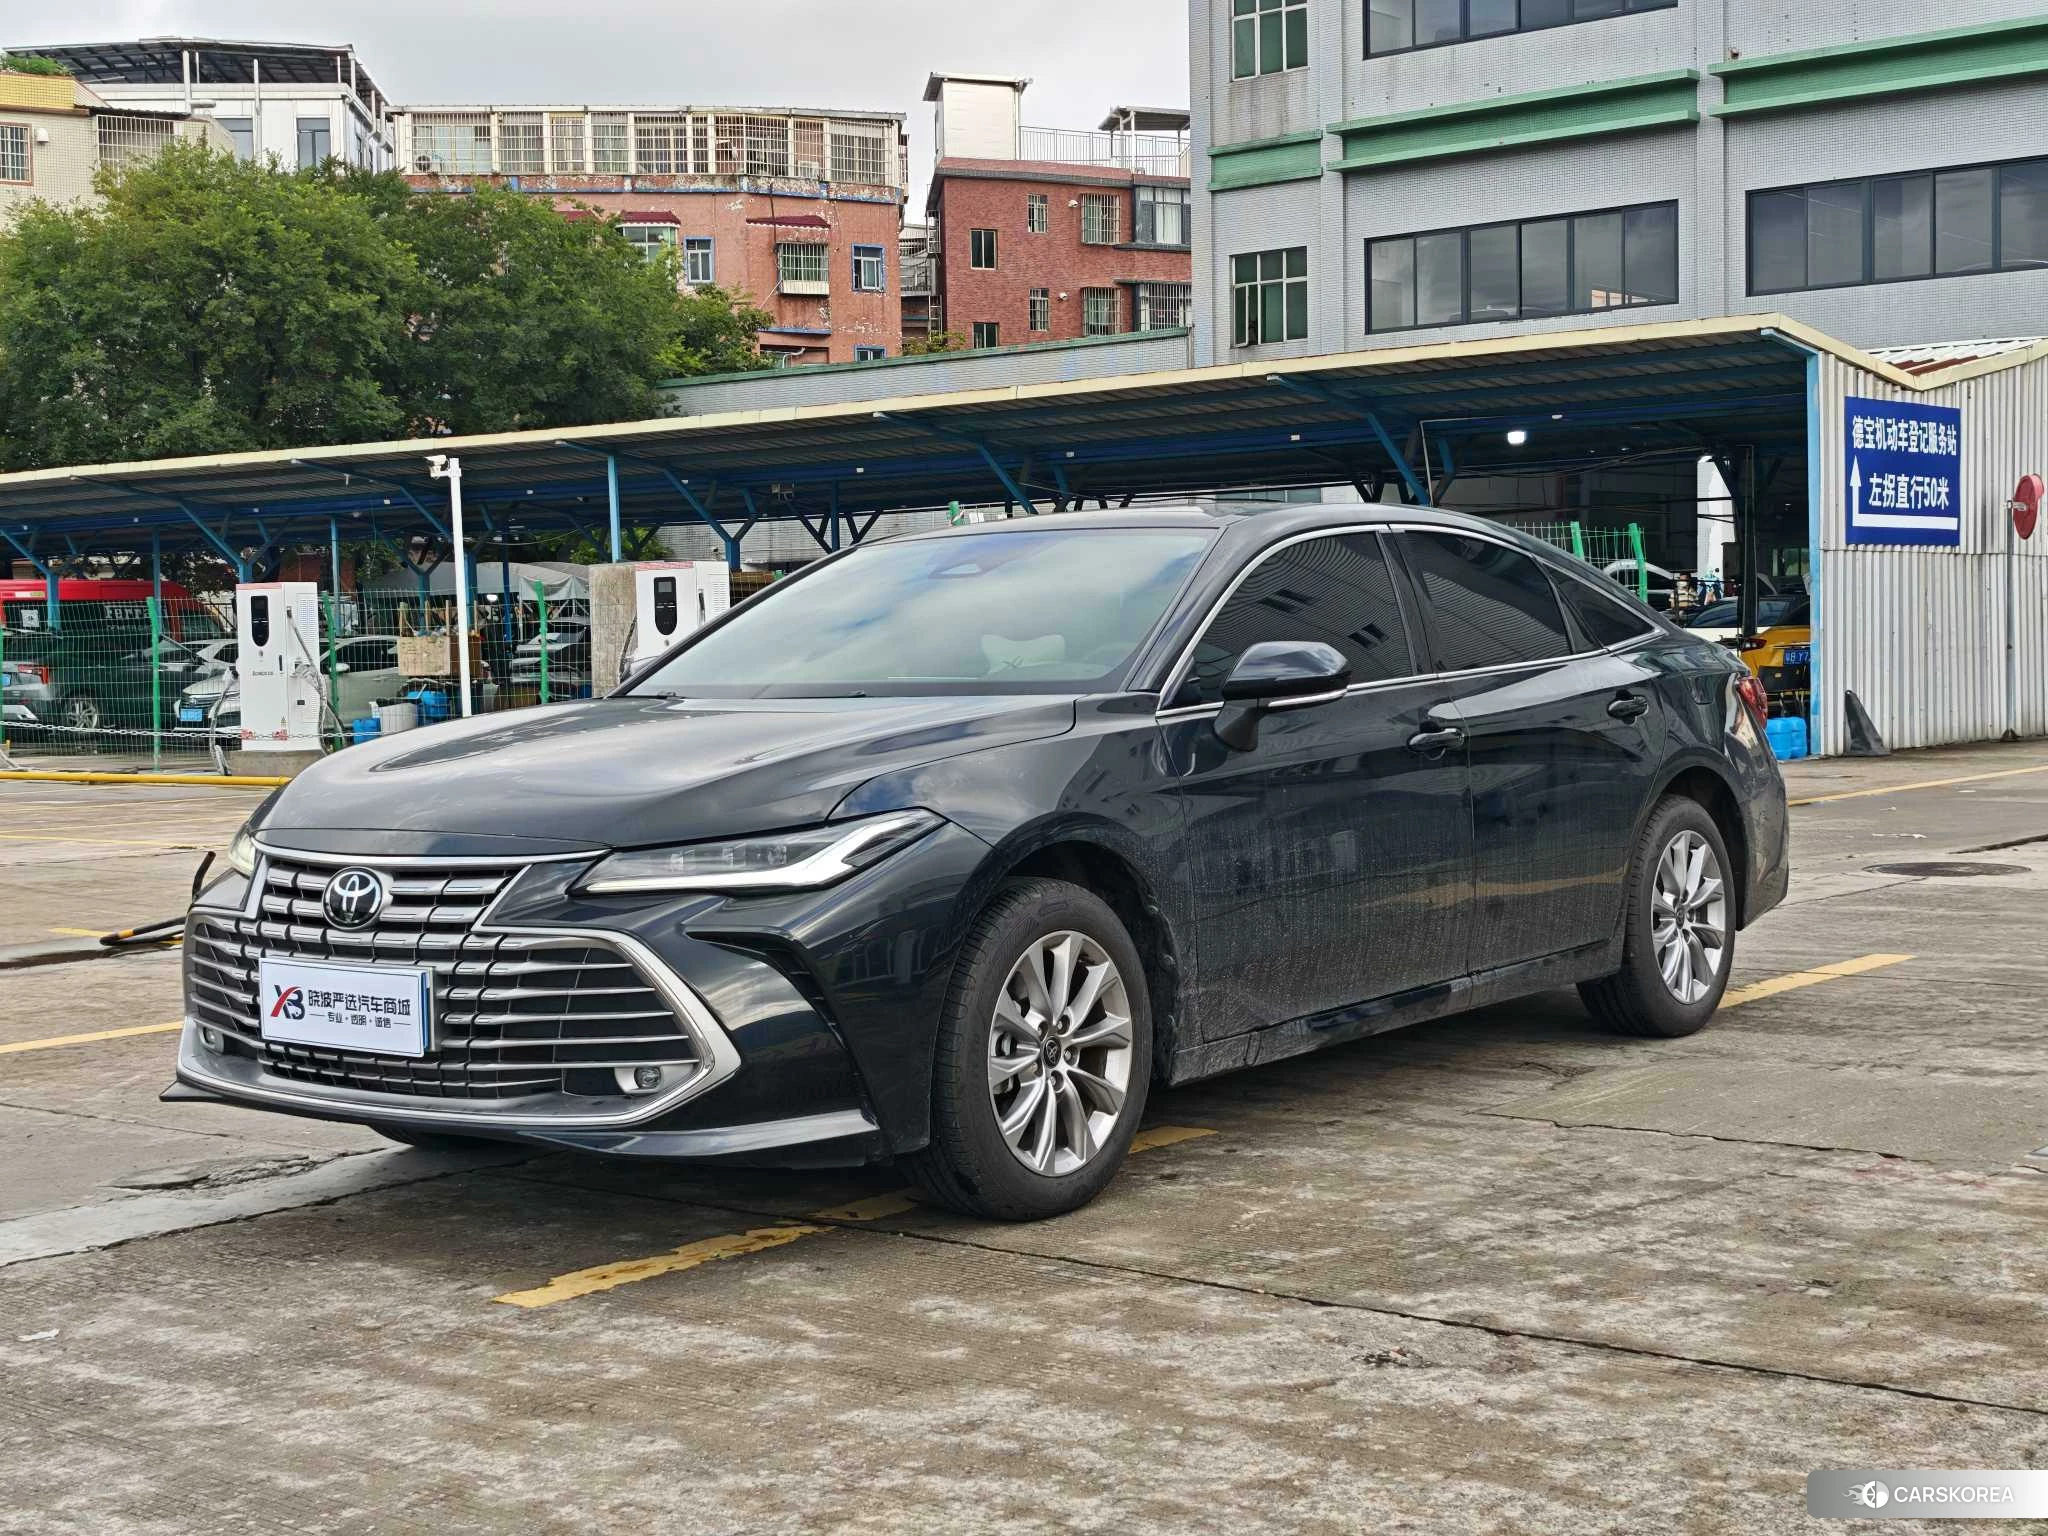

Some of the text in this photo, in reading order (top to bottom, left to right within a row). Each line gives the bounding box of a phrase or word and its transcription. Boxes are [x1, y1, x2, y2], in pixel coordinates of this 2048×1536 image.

[1852, 415, 1957, 456] 德宝机动车登记服务站
[1869, 473, 1949, 510] 左拐直行50米
[308, 989, 411, 1016] 晓波严选汽车商城
